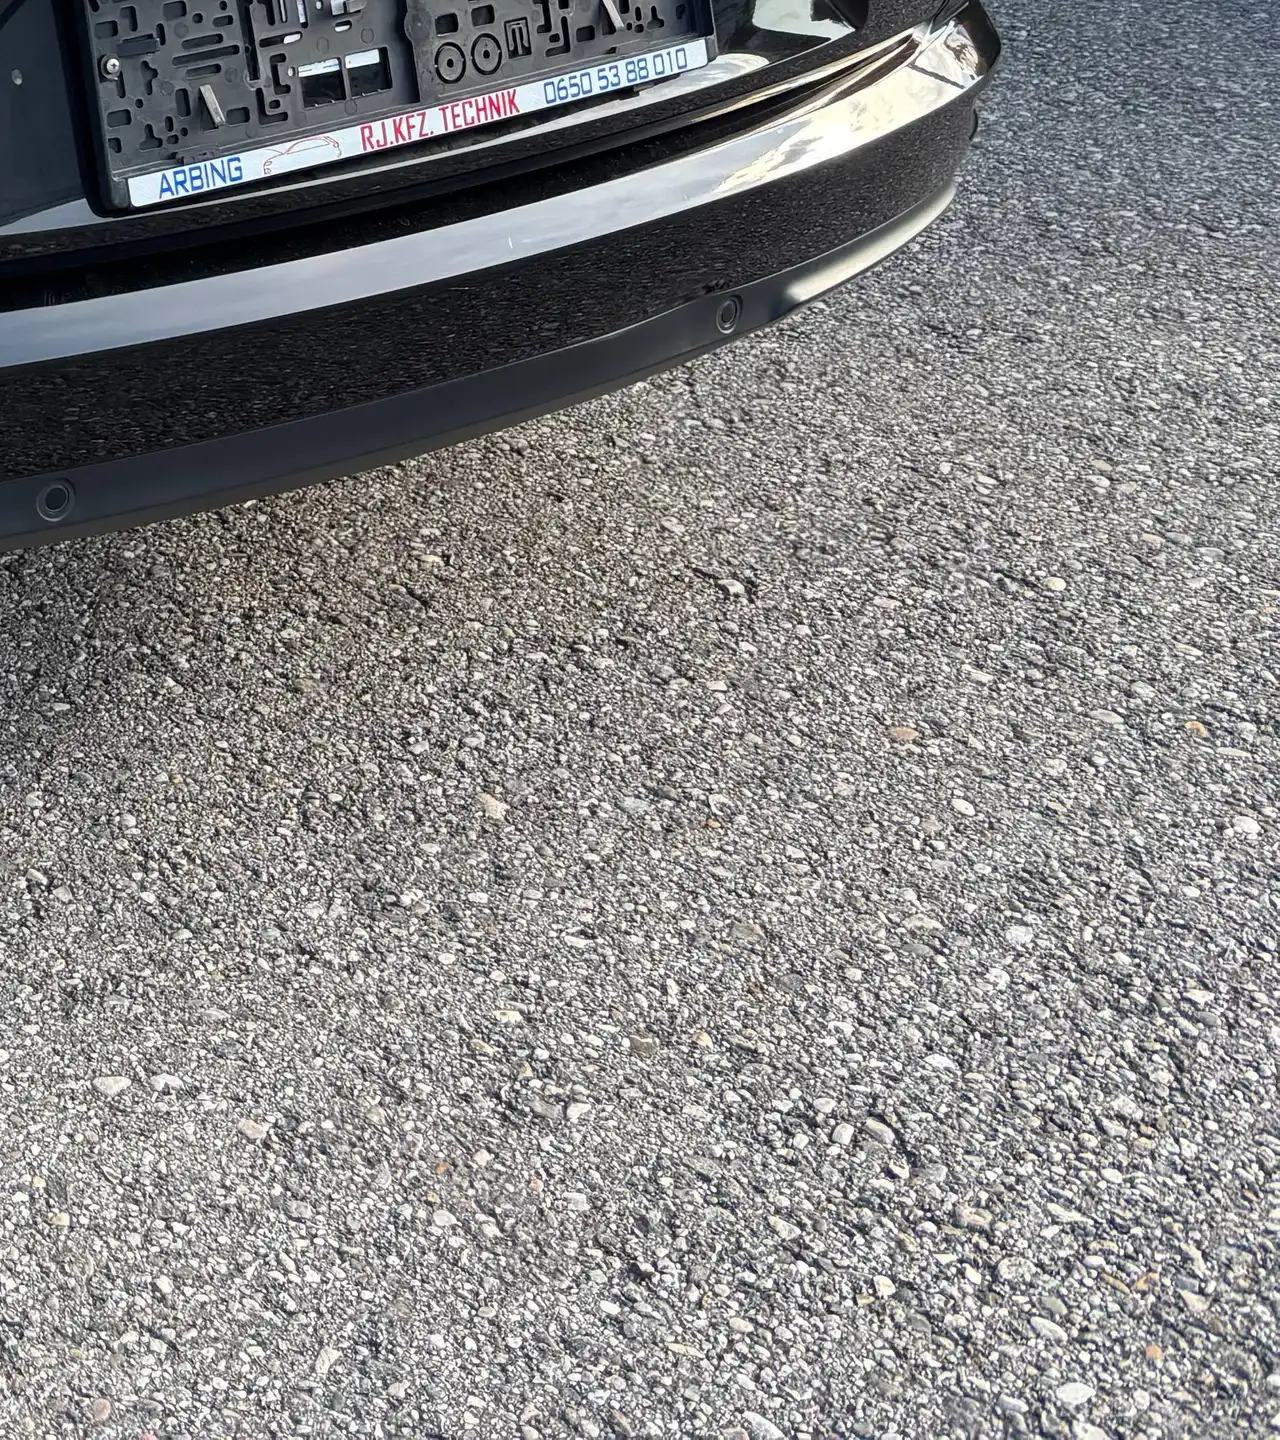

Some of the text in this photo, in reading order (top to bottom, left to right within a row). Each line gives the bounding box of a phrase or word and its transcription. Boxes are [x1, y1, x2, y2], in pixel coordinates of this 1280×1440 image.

[159, 157, 244, 199] ARBING
[438, 89, 521, 132] TECHNIK
[544, 71, 593, 105] 0650
[598, 64, 622, 91] 53
[626, 56, 649, 82] 88
[654, 46, 688, 76] 010
